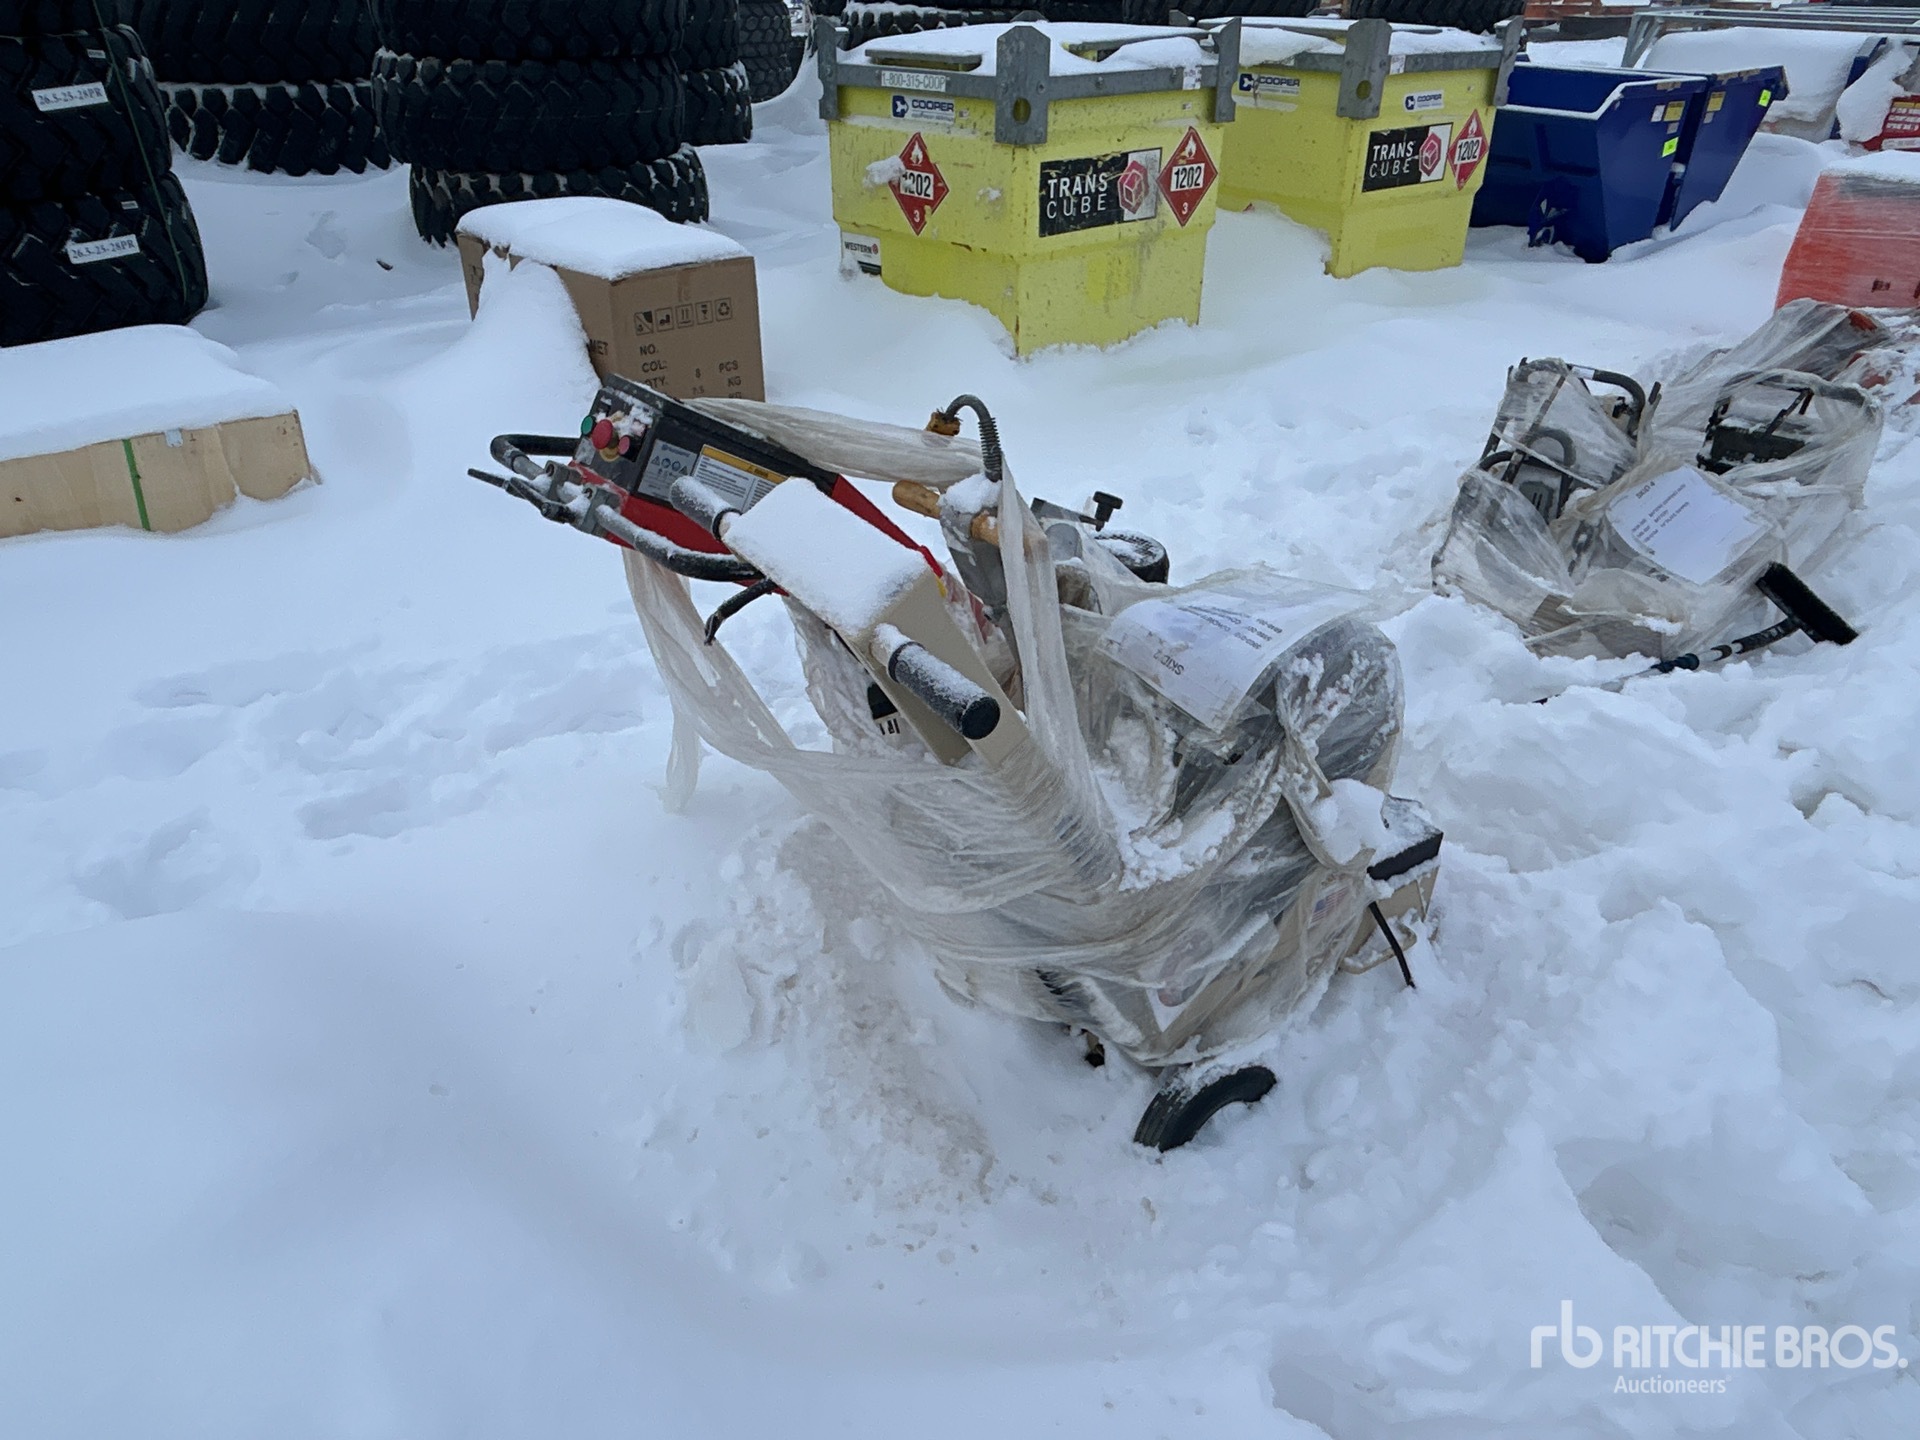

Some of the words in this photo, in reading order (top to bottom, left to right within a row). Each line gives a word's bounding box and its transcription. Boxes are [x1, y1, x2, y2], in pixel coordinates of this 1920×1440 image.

[1258, 76, 1300, 87] COOPER
[912, 99, 954, 111] COOPER
[1372, 141, 1414, 161] TRANS
[1457, 140, 1480, 162] 1202
[1369, 159, 1411, 178] CUBE
[1174, 165, 1203, 190] 1202
[1047, 174, 1109, 199] TRANS
[1046, 193, 1107, 219] CUBE
[1181, 202, 1189, 215] 3
[913, 210, 920, 223] 3
[844, 241, 872, 254] WESTERN
[719, 360, 739, 373] PCS
